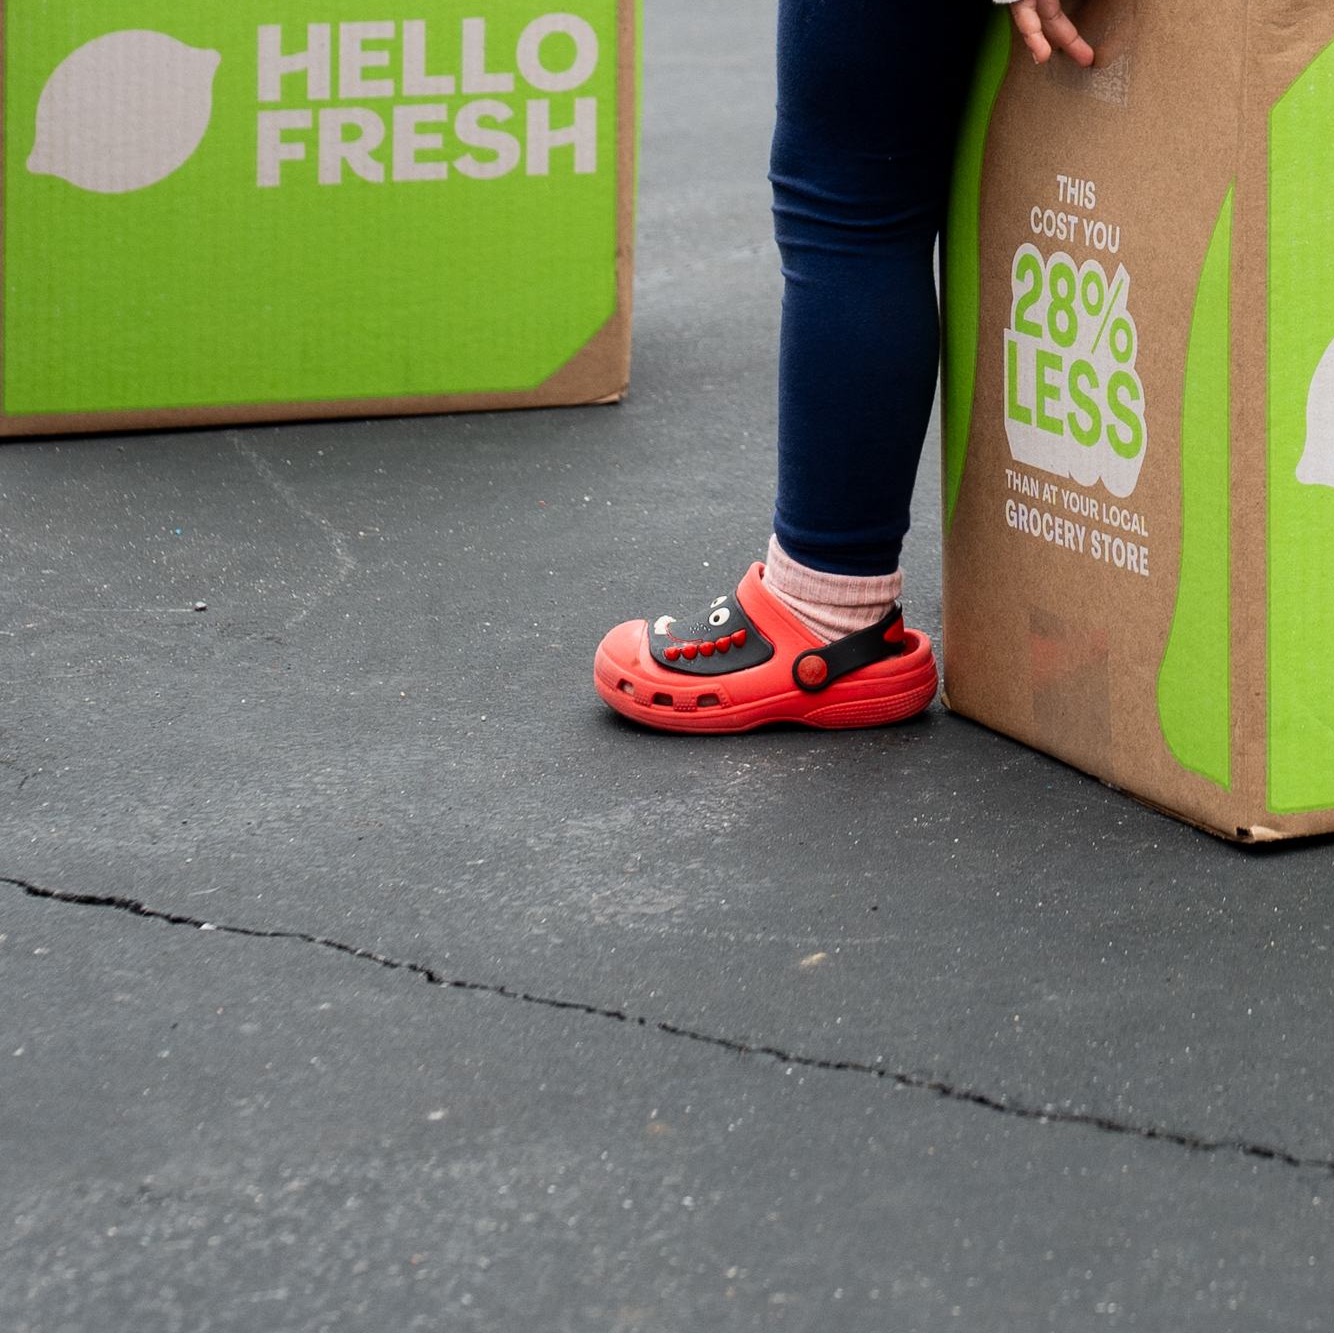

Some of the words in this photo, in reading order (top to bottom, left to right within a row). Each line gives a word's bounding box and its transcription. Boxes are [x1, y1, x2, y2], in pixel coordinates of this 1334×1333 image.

[257, 12, 599, 102] HELLO
[256, 97, 597, 188] FRESH
[1030, 205, 1079, 243] COST
[1083, 218, 1121, 254] YOU
[1056, 174, 1096, 209] THIS
[1014, 253, 1133, 364] 28%
[1007, 339, 1143, 459] LESS
[1005, 468, 1040, 500] THAN
[1042, 482, 1059, 506] AT
[1061, 488, 1099, 521] YOUR
[1102, 502, 1149, 537] LOCAL
[1005, 498, 1086, 554] GROCERY
[1090, 529, 1149, 577] STORE
